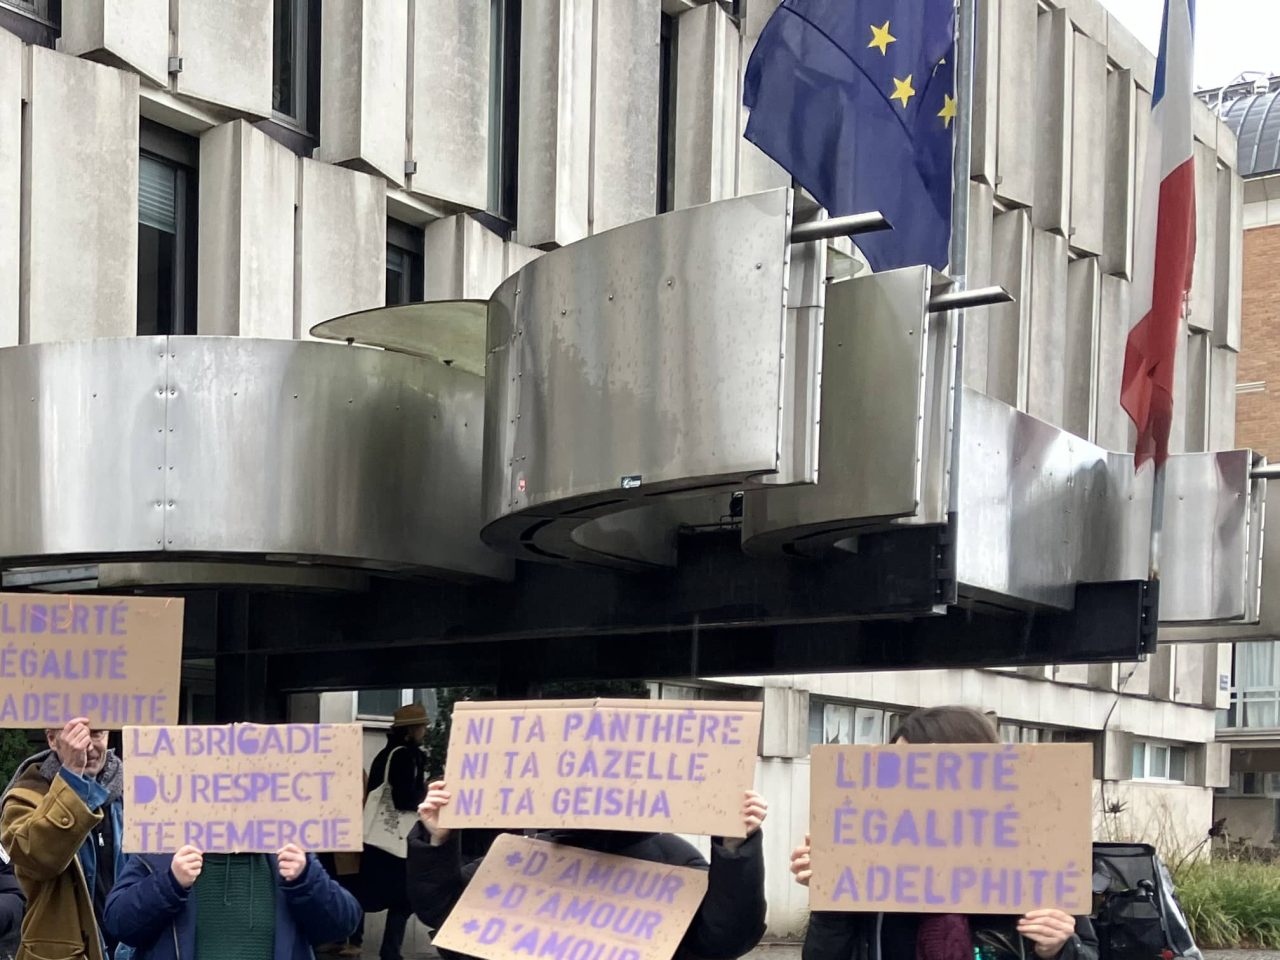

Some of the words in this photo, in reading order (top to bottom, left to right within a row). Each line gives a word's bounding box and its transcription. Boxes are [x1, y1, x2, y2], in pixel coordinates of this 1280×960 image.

[1, 600, 128, 635] LIBERTÉ
[0, 642, 128, 680] ÉGALITÉ
[0, 690, 167, 724] ADELPHITÉ
[133, 727, 176, 757] LA
[184, 724, 333, 756] BRIGADE
[465, 717, 494, 745] NI
[510, 715, 546, 744] TA
[563, 708, 744, 745] PANTHÈRE
[460, 752, 488, 780] NI
[504, 751, 539, 779] TA
[556, 750, 709, 782] GAZELLE
[835, 744, 1020, 792] LIBERTÉ
[133, 773, 183, 804] DU
[191, 771, 336, 803] RESPECT
[455, 788, 484, 816] NI
[499, 787, 534, 815] TA
[552, 786, 671, 818] GEISHA
[133, 821, 177, 851] TE
[184, 818, 351, 851] REMERCIE
[832, 795, 1020, 848] ÉGALITÉ
[831, 861, 1083, 908] ADELPHITÉ
